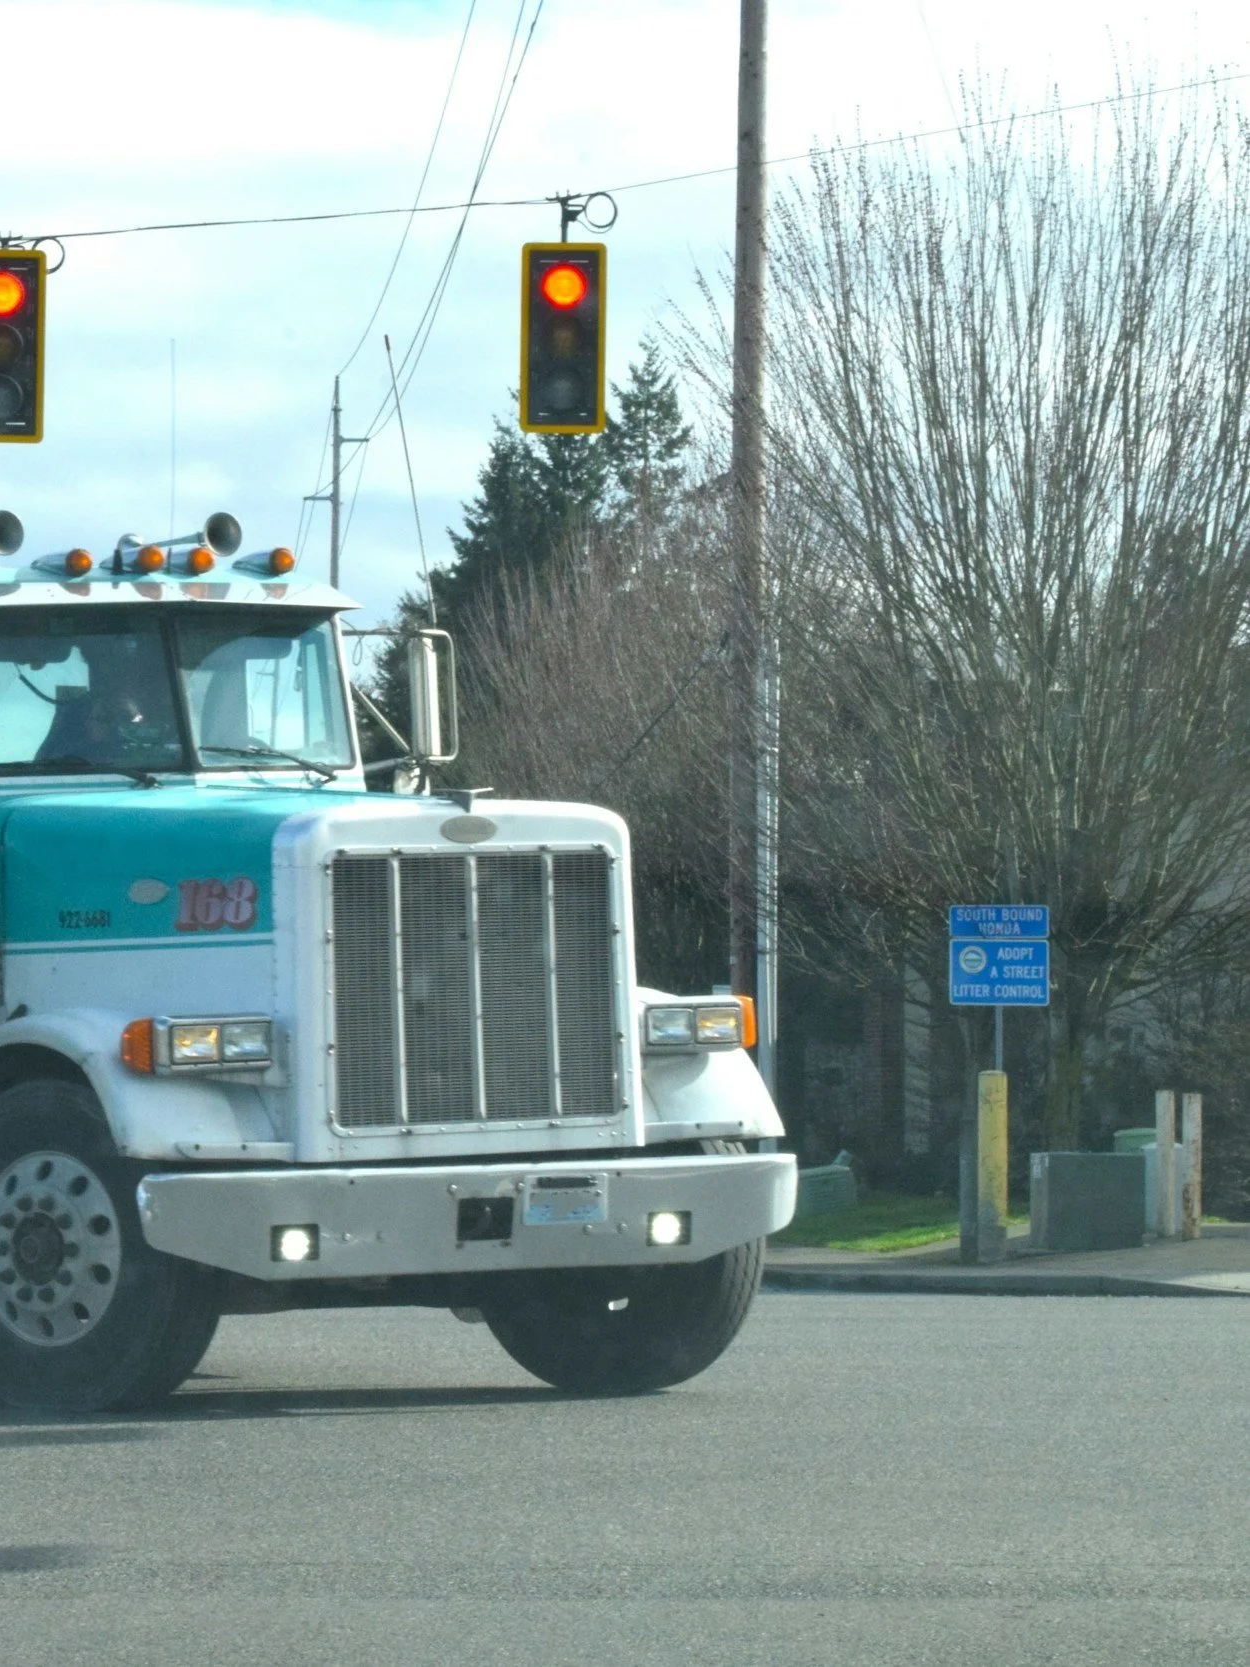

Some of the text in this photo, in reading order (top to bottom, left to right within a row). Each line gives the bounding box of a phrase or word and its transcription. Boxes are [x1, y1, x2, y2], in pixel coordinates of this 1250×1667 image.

[175, 876, 257, 931] 168
[956, 908, 1043, 921] SOUTH BOUND
[978, 922, 1021, 935] HONDA
[997, 947, 1034, 961] ADOPT
[990, 966, 1045, 979] A STREET
[953, 984, 1045, 999] LITTER CONTROL
